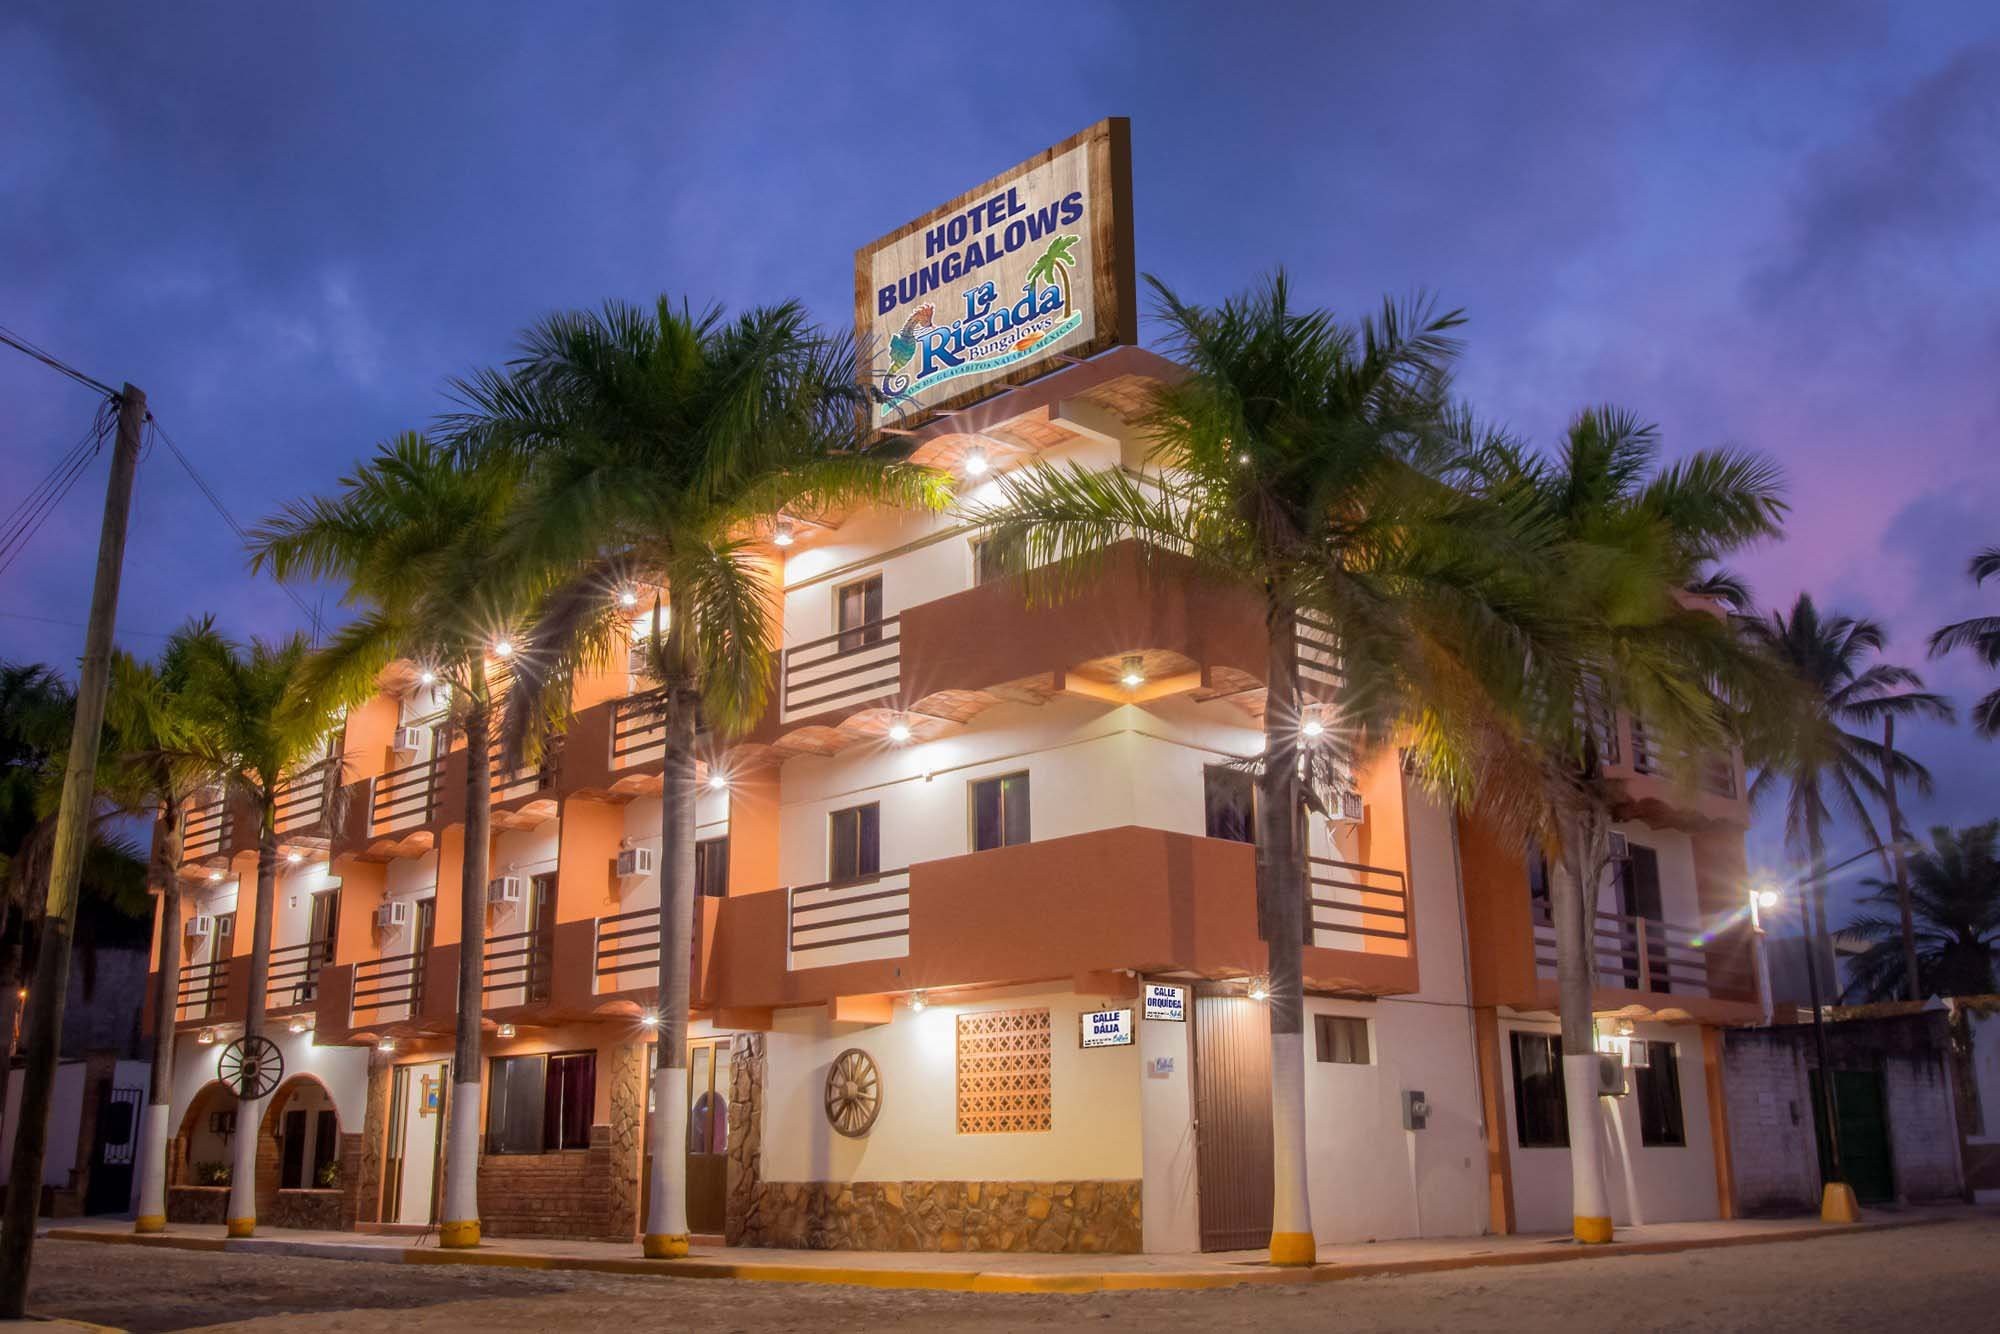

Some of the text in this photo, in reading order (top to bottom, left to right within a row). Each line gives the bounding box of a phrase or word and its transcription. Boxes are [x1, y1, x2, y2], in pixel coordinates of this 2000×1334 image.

[925, 187, 1026, 259] HOTEL
[878, 192, 1084, 316] BUNGALOWS
[963, 279, 997, 325] La
[917, 285, 1064, 379] Rienda
[969, 318, 1052, 361] Bungalows
[1147, 997, 1182, 1009] ORQUÍDEA
[1154, 987, 1175, 997] CALLE
[1093, 1012, 1120, 1023] CALLE
[1093, 1022, 1120, 1034] DÁLIA
